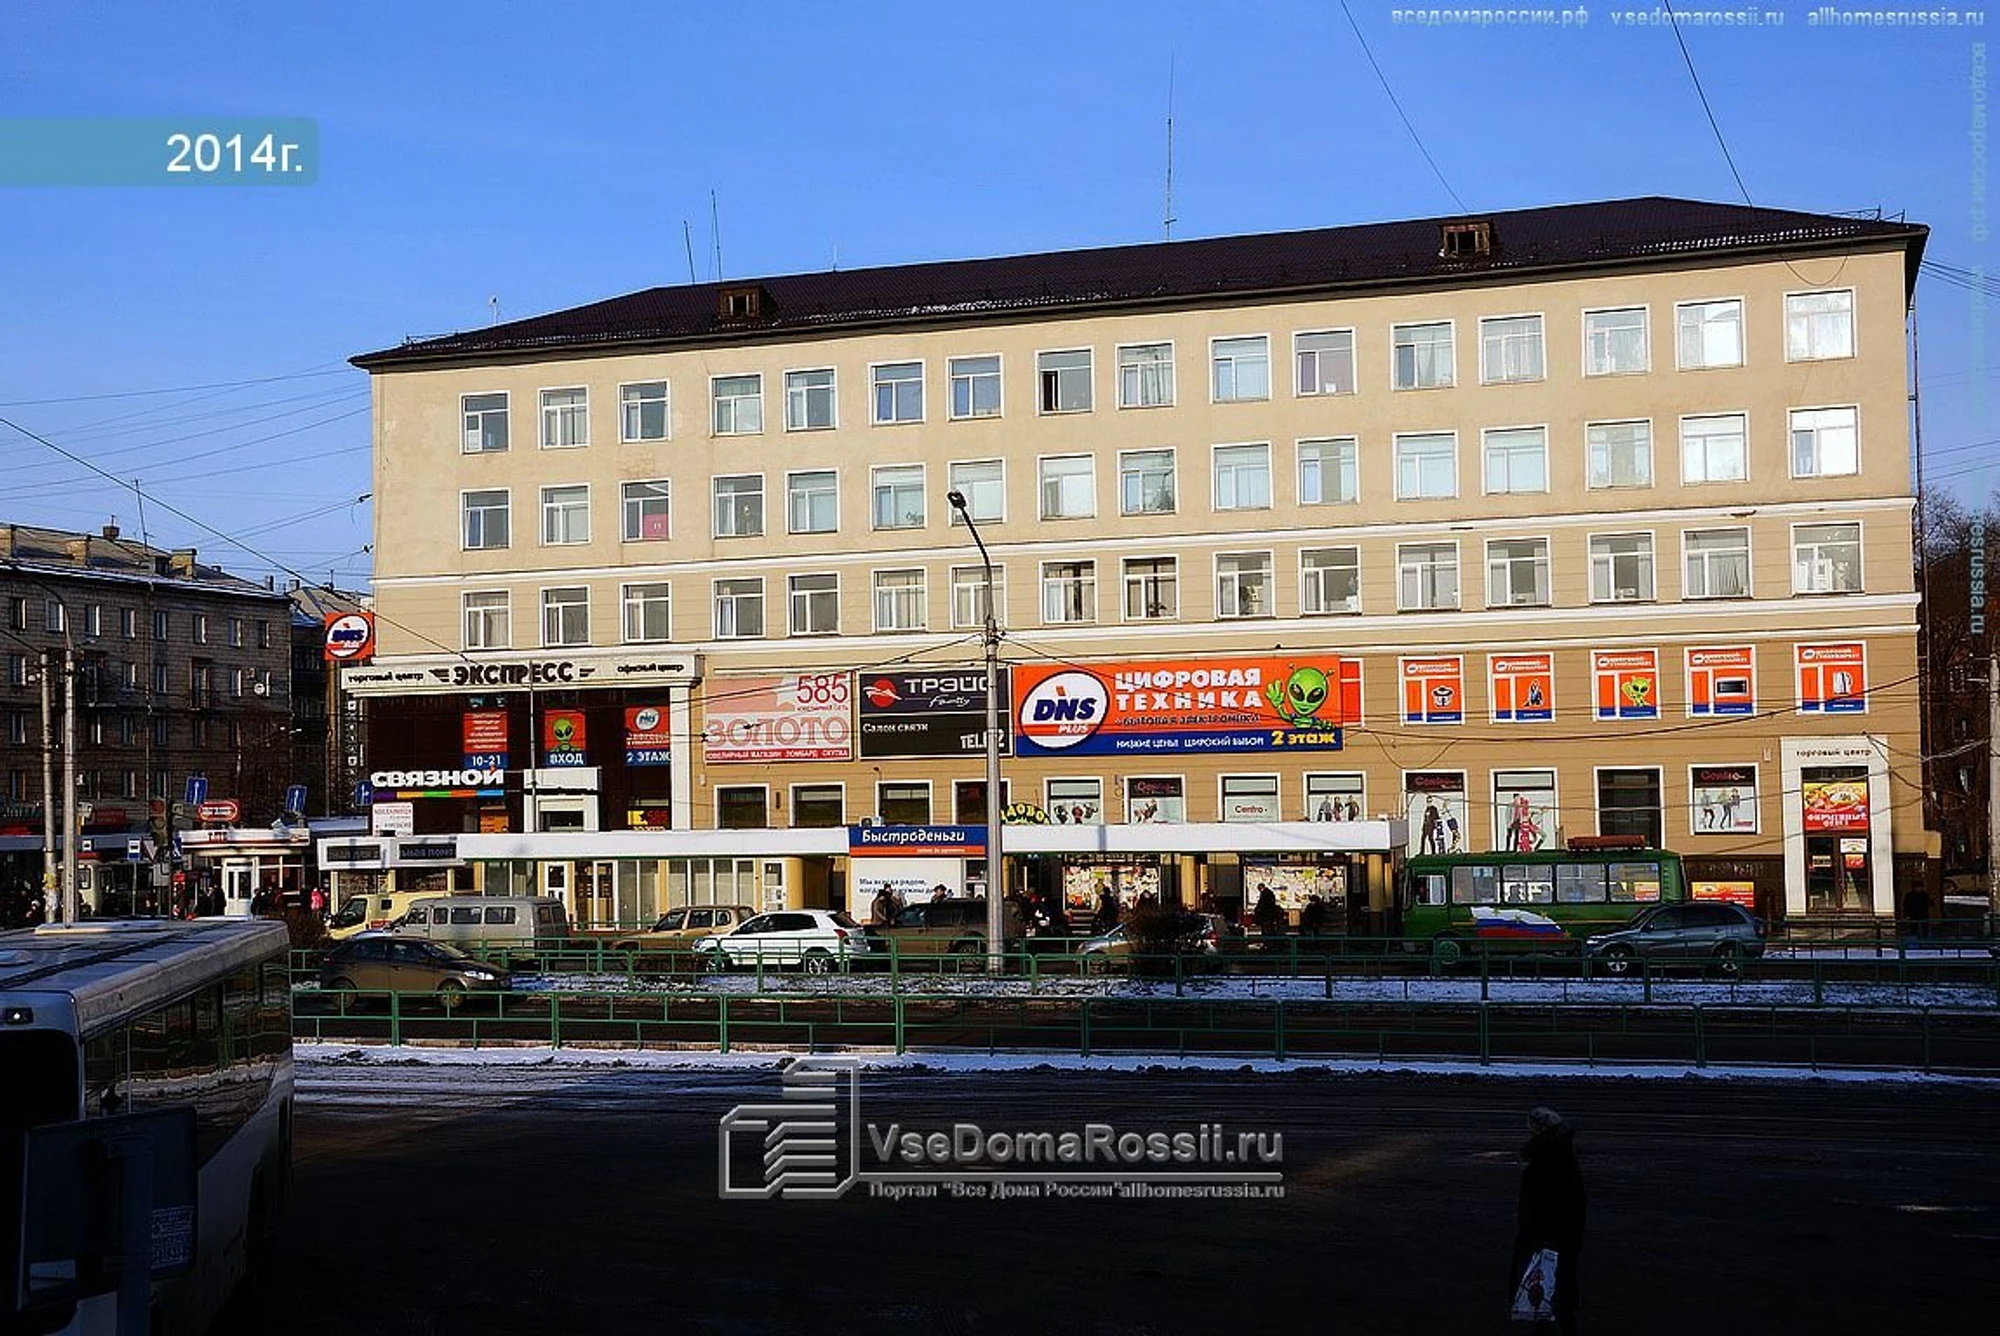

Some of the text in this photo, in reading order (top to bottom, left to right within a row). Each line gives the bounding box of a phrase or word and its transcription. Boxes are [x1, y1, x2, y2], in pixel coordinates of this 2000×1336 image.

[453, 661, 574, 685] ЭКСПРЕСС
[1114, 667, 1261, 692] ЦИФРОВАЯ
[796, 675, 849, 704] 585
[1033, 697, 1097, 721] DNS
[1115, 690, 1264, 711] ТЕХНИКА
[706, 715, 850, 747] ЗОЛОТО
[862, 723, 896, 734] Салон
[1058, 724, 1089, 734] PLUS
[1271, 730, 1284, 746] 2
[472, 755, 501, 767] 10-21
[549, 752, 585, 765] ВХОД
[1796, 748, 1873, 758] торговый центр
[371, 766, 504, 788] СВЯЗНОЙ
[1234, 804, 1264, 814] Centro
[862, 828, 966, 845] Быстроденьги
